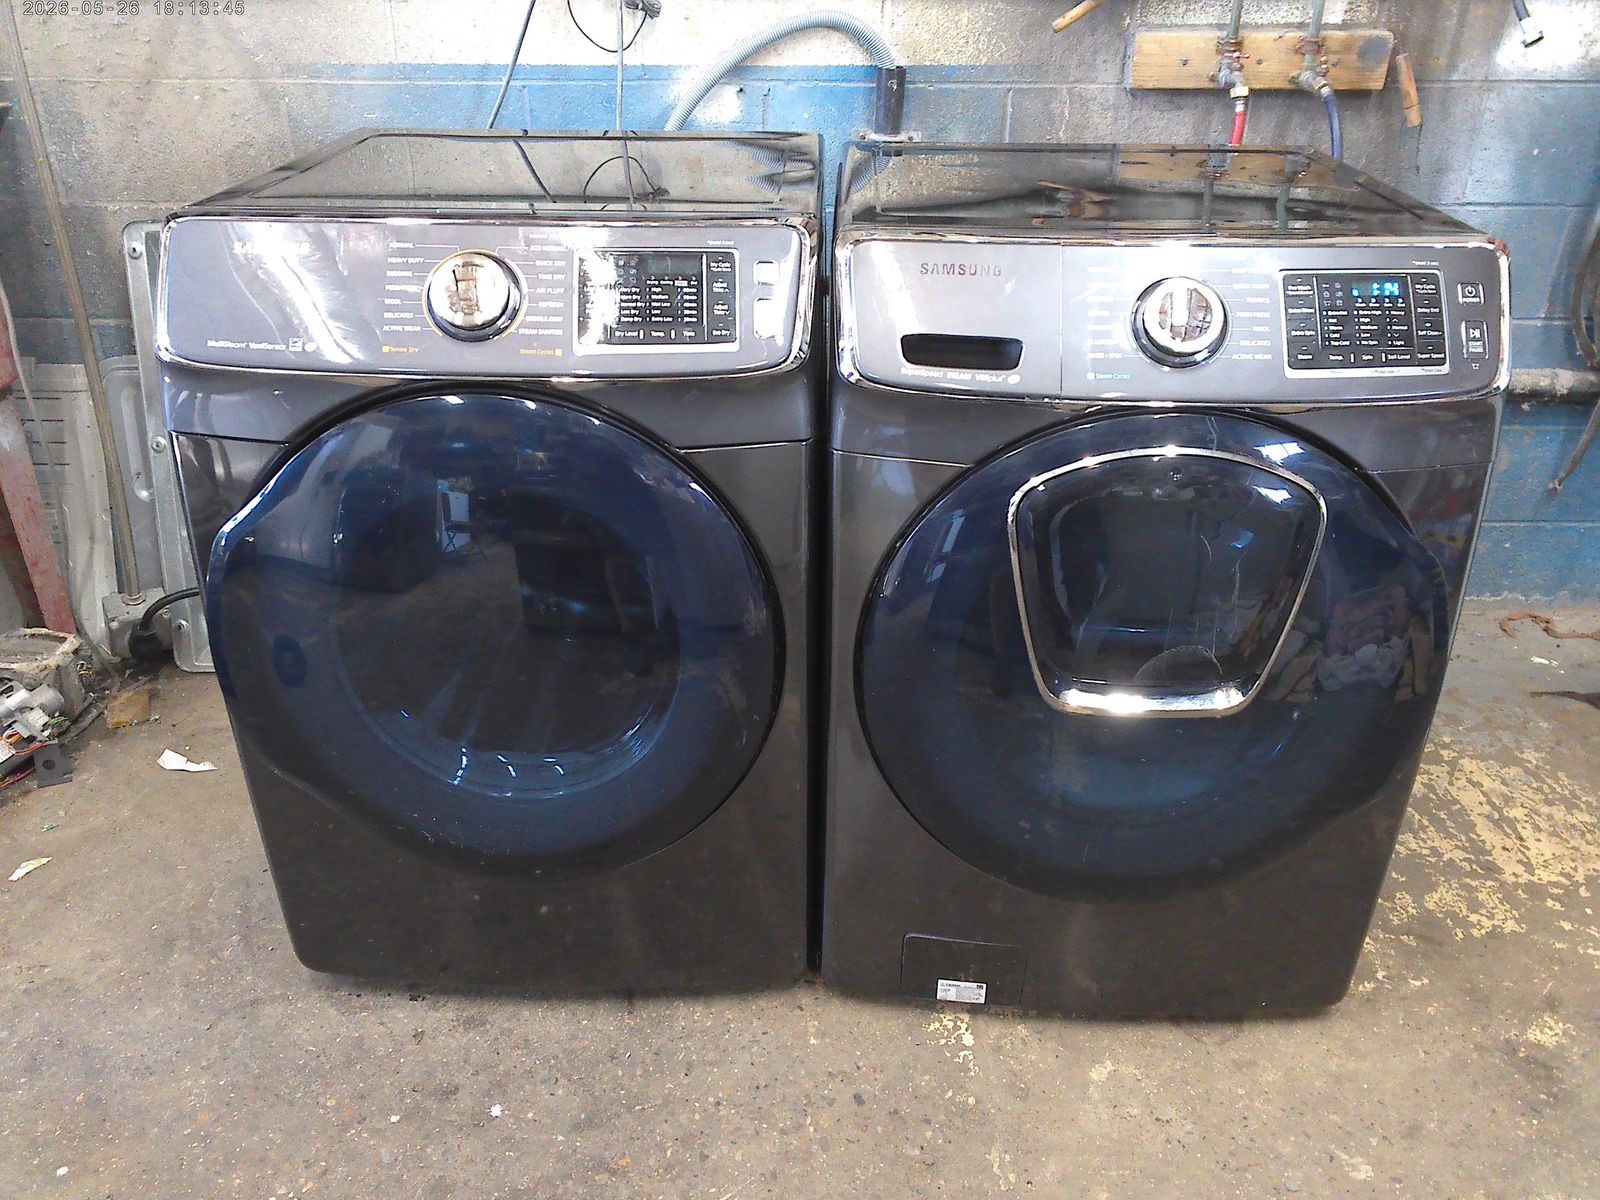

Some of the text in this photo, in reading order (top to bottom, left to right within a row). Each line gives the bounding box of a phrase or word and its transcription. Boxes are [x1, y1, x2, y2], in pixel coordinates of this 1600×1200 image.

[919, 262, 1002, 277] SAMSUNG
[1430, 306, 1440, 314] End
[408, 346, 419, 354] Dry
[1231, 353, 1253, 361] ACTIVE
